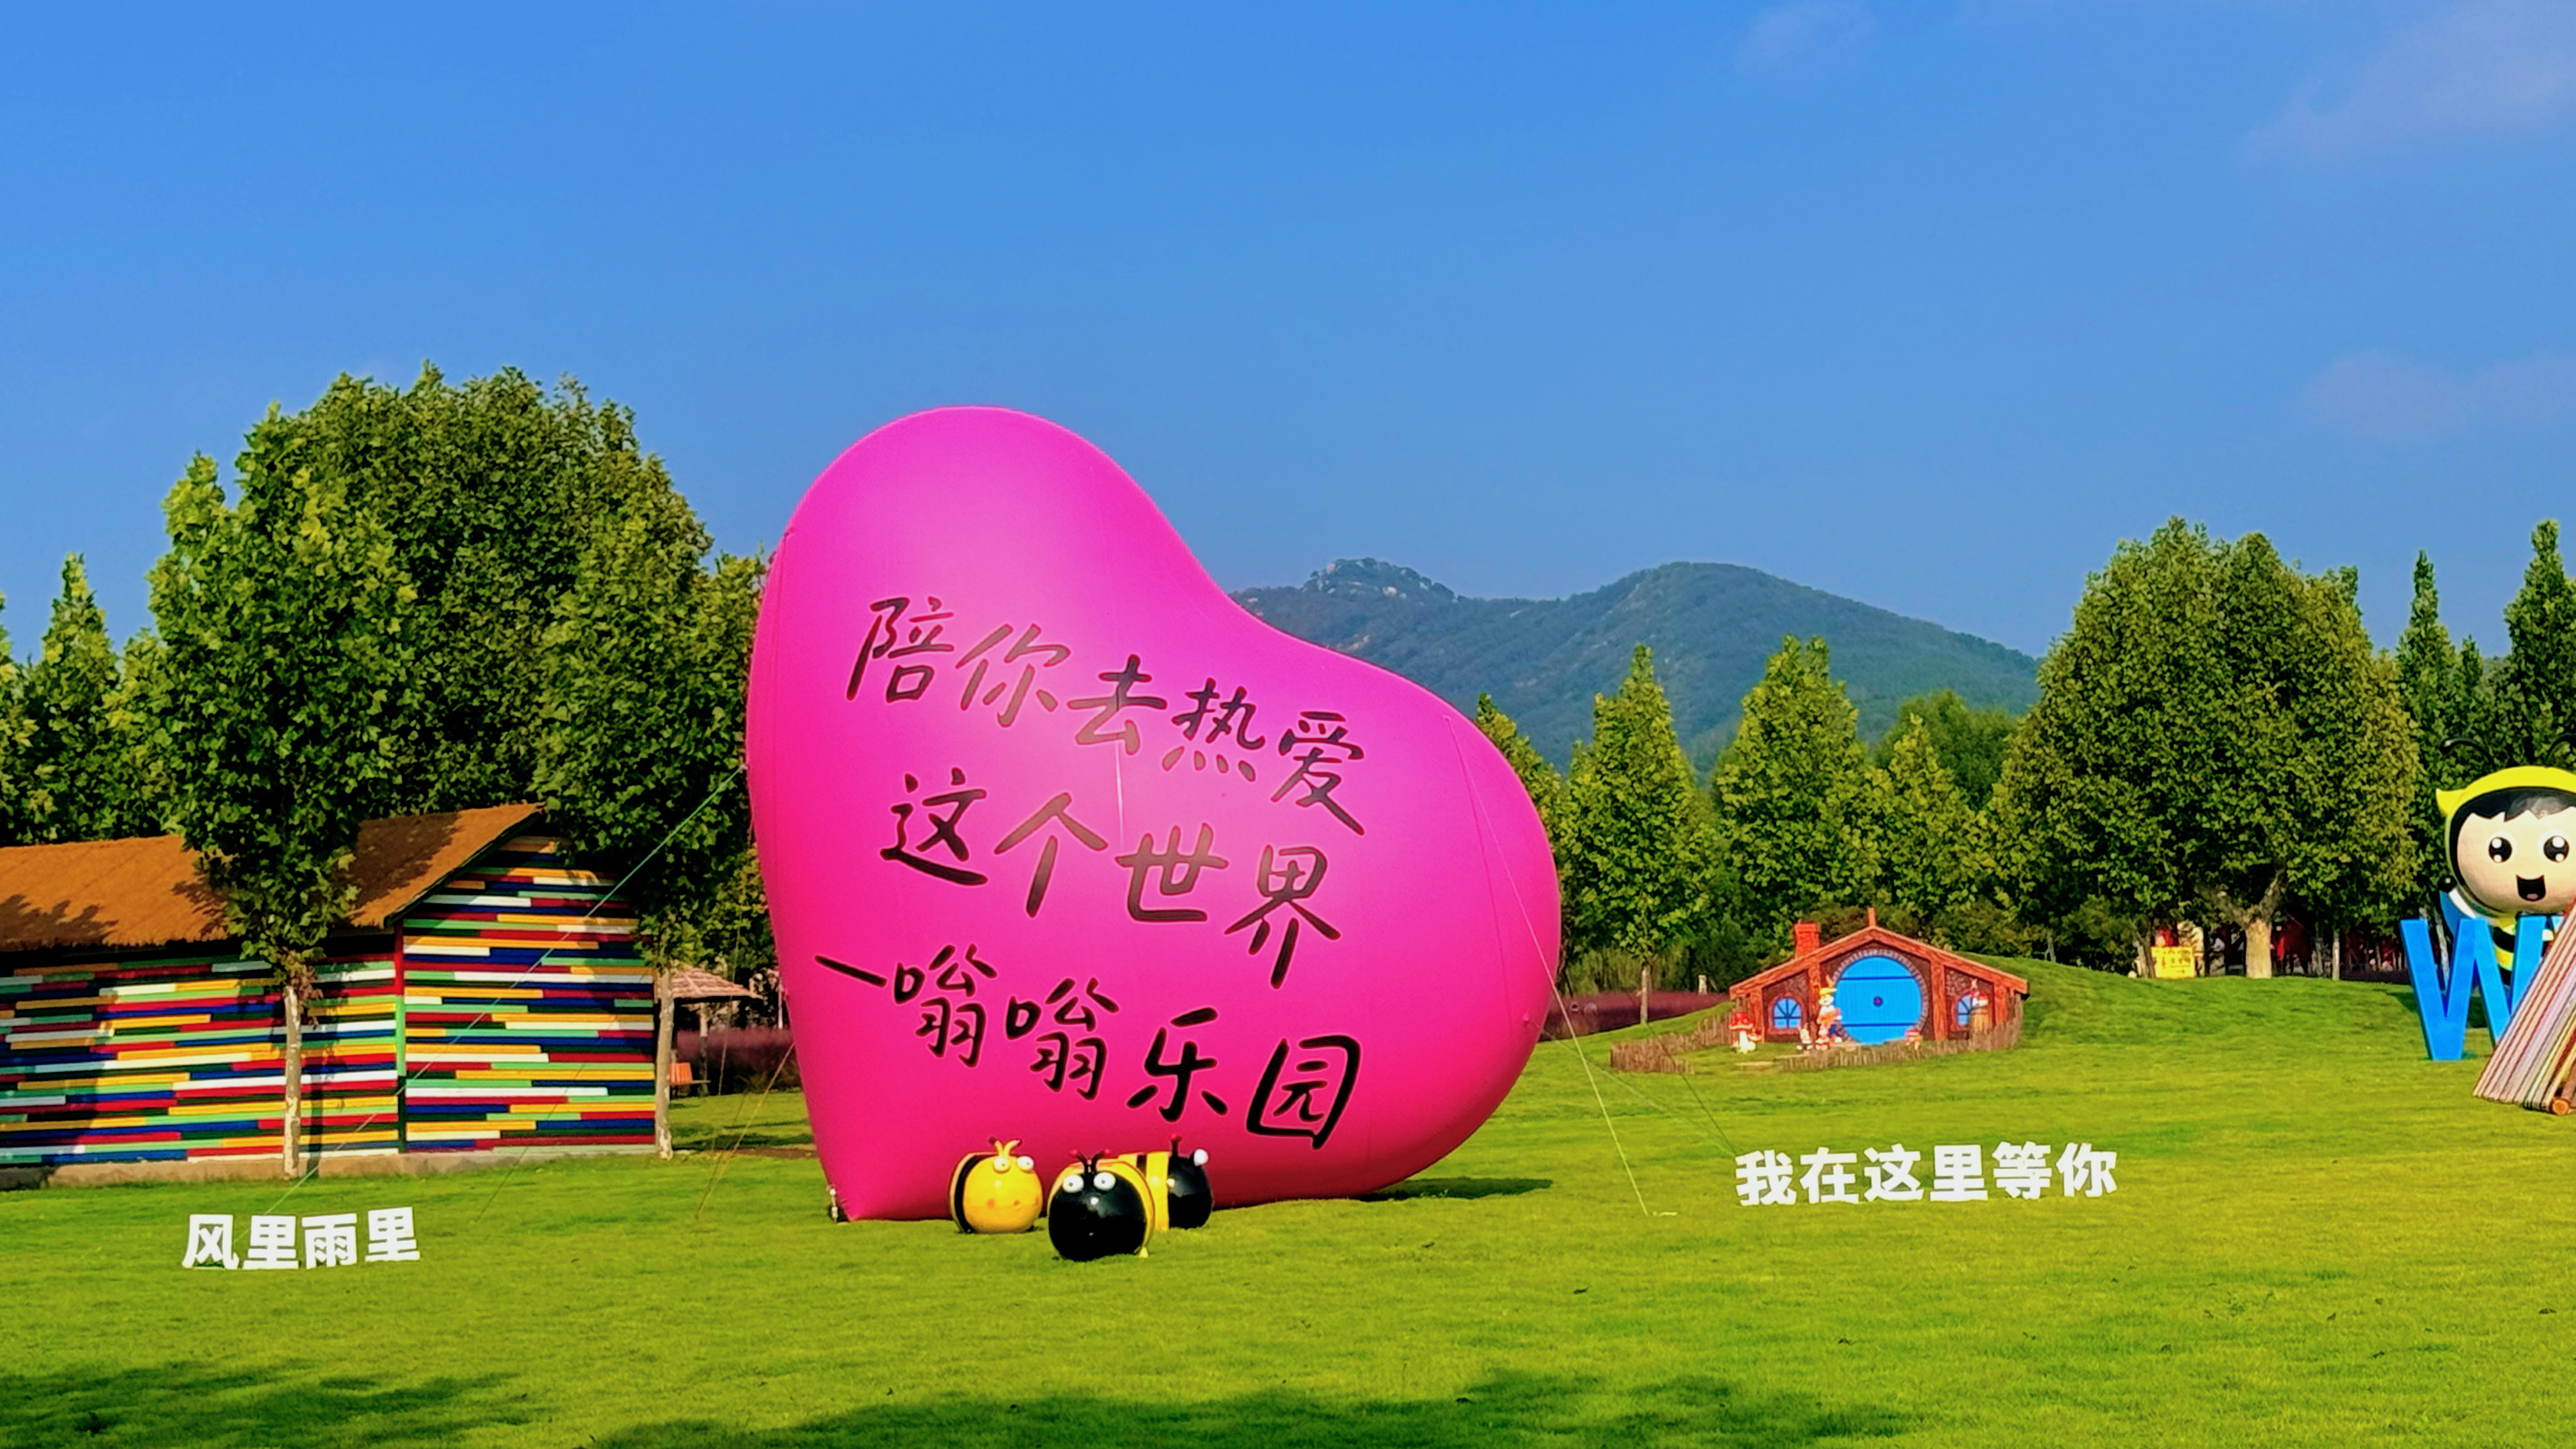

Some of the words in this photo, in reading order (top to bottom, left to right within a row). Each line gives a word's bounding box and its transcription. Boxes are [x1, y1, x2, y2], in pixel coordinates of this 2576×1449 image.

[845, 596, 1365, 835] 陪你去热爱
[880, 768, 1342, 989] 这个世界
[2400, 916, 2564, 1061] W
[182, 1207, 420, 1270] 风里雨里
[1735, 1140, 2117, 1206] 我在这里等你
